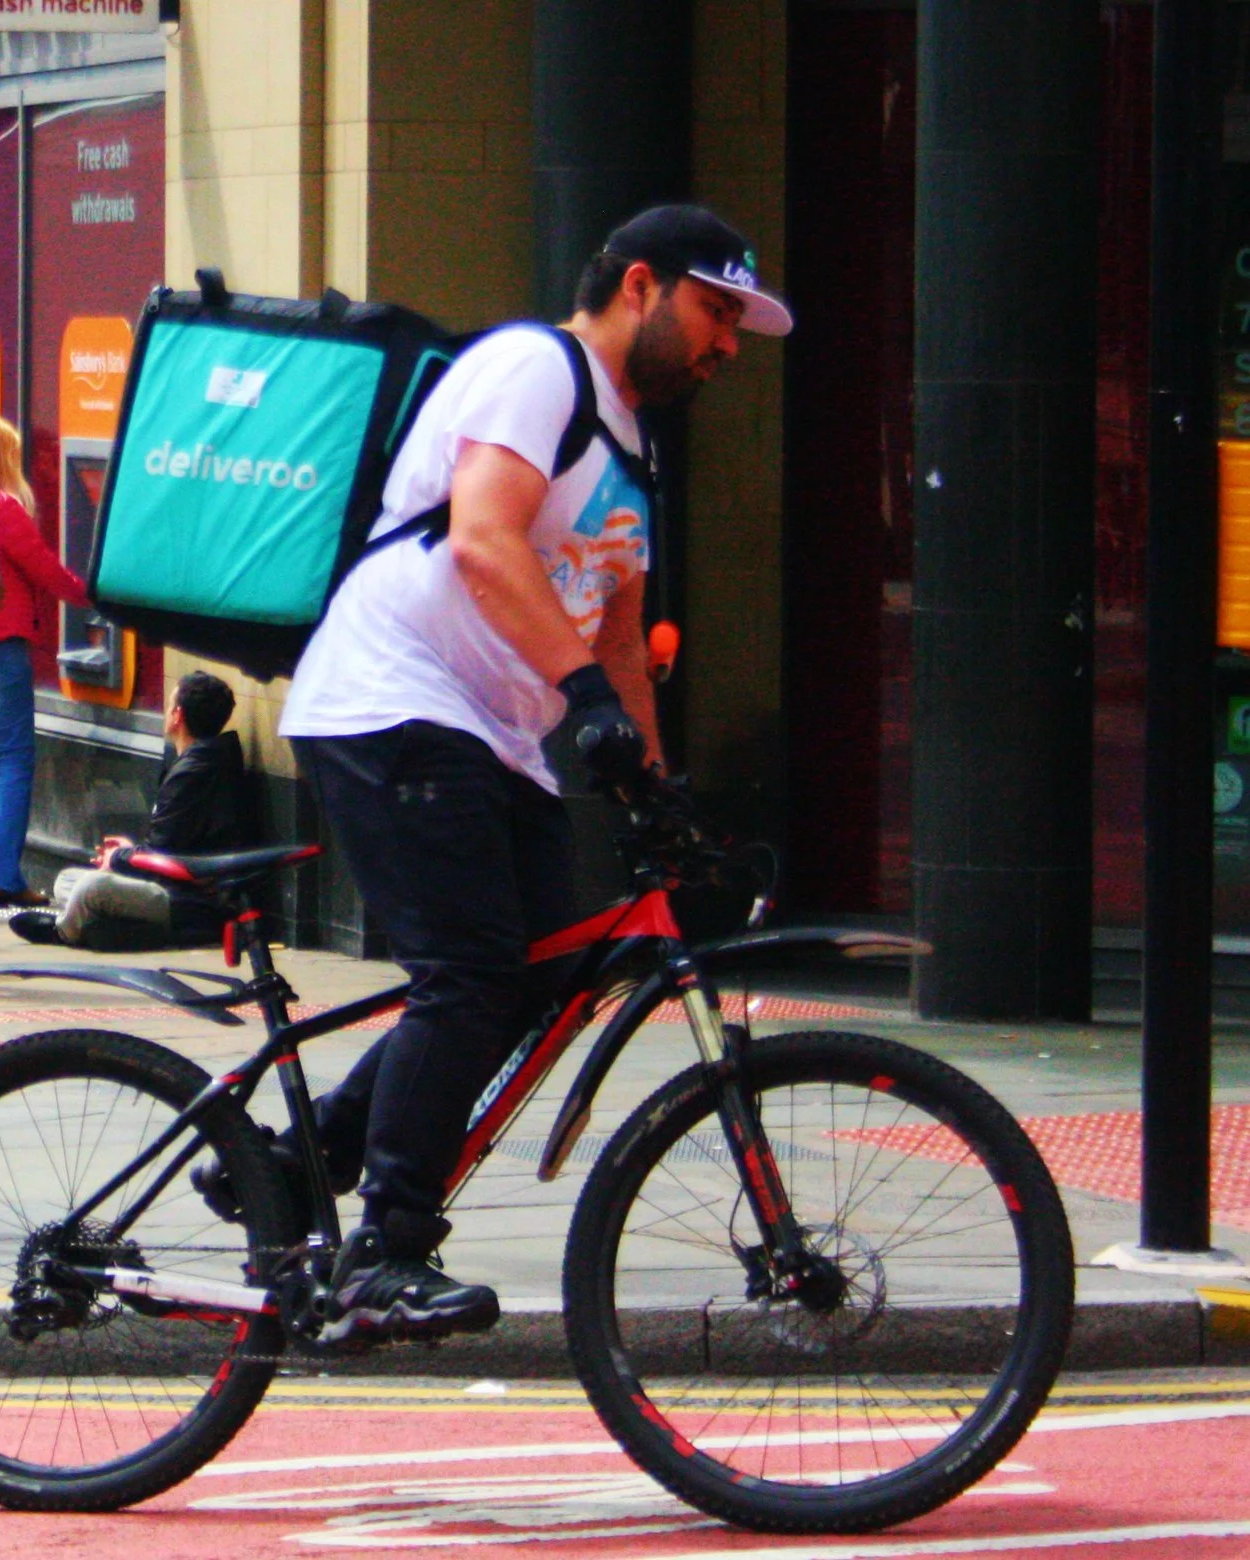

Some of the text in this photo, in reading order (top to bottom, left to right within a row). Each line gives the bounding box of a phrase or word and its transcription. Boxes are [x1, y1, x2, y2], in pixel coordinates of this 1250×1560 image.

[77, 137, 129, 172] Free cash
[71, 190, 135, 225] withdrawals
[145, 440, 318, 491] deliveroo
